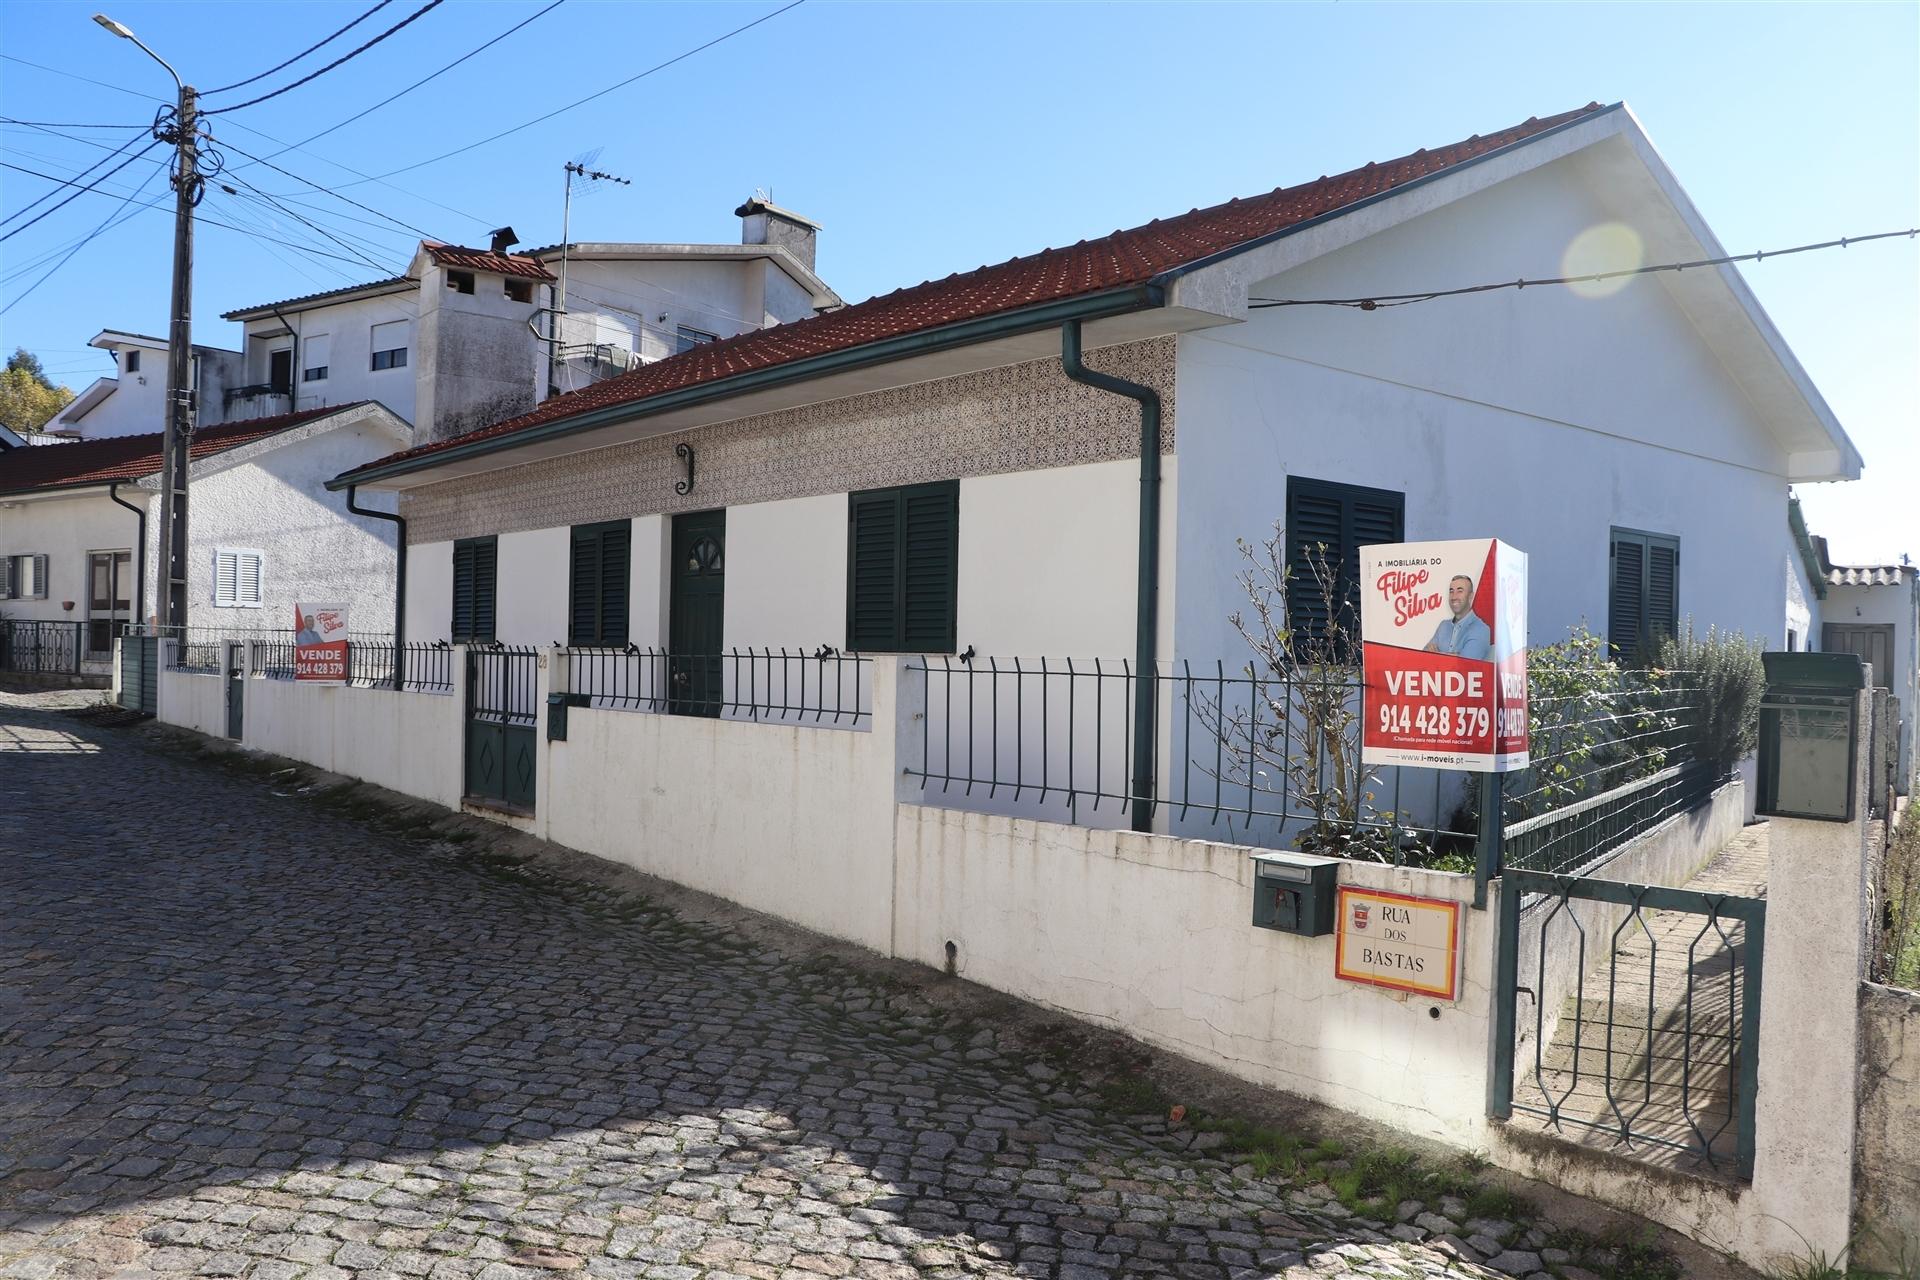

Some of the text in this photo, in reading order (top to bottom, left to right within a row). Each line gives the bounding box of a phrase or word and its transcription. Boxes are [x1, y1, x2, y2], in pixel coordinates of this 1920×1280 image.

[1385, 557, 1427, 567] IMOBILIÁRIA
[1376, 569, 1429, 601] Filipe
[1394, 592, 1442, 627] Silva
[299, 649, 341, 660] VENDE
[297, 663, 344, 674] 914 428 379
[1384, 670, 1484, 698] VENDE
[1380, 704, 1411, 733] 914
[1415, 705, 1451, 736] 428
[1455, 706, 1490, 738] 379
[1400, 753, 1464, 765] www.i-moveis.pt
[1382, 906, 1411, 924] RUA
[1384, 928, 1407, 942] DOS
[1363, 948, 1425, 972] BASTAS
